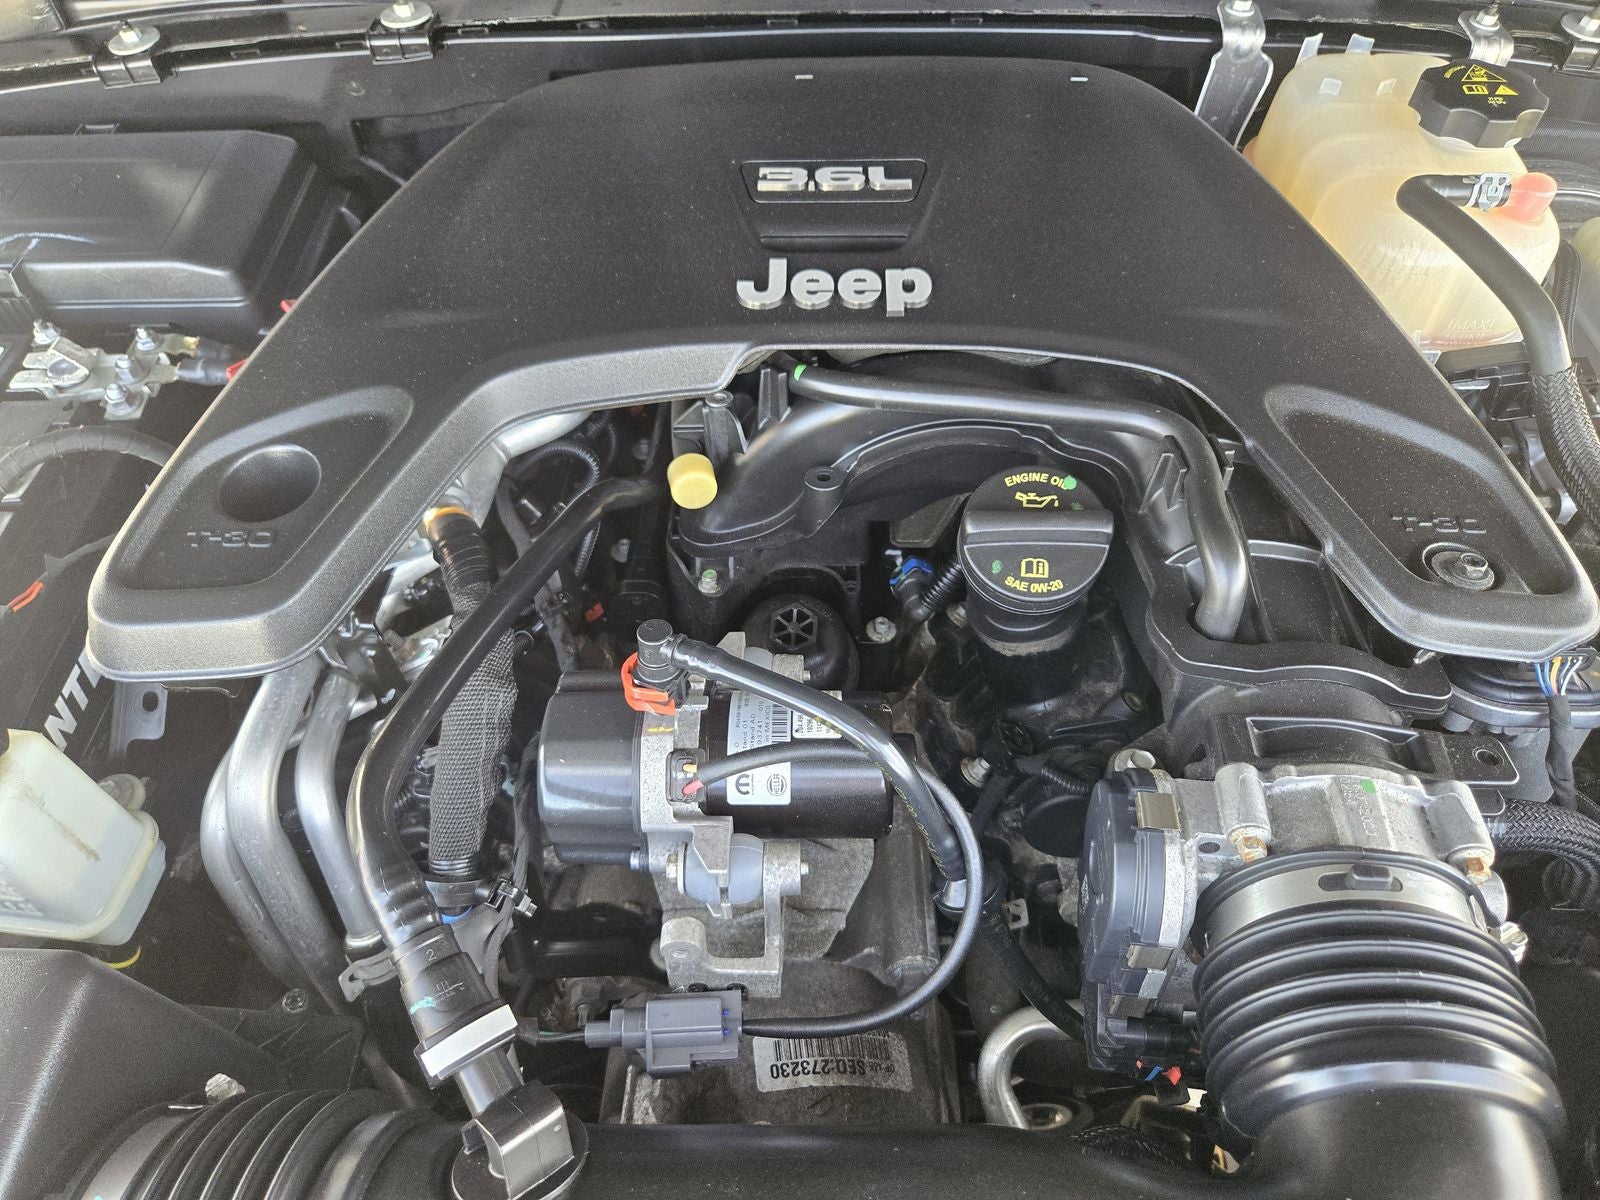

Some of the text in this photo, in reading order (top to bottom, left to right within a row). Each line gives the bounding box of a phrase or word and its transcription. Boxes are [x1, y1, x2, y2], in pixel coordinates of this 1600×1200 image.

[757, 166, 913, 192] 3.6L
[736, 257, 933, 317] Jeep
[1004, 472, 1049, 487] ENGINE
[1004, 576, 1064, 593] SAE 0W-20
